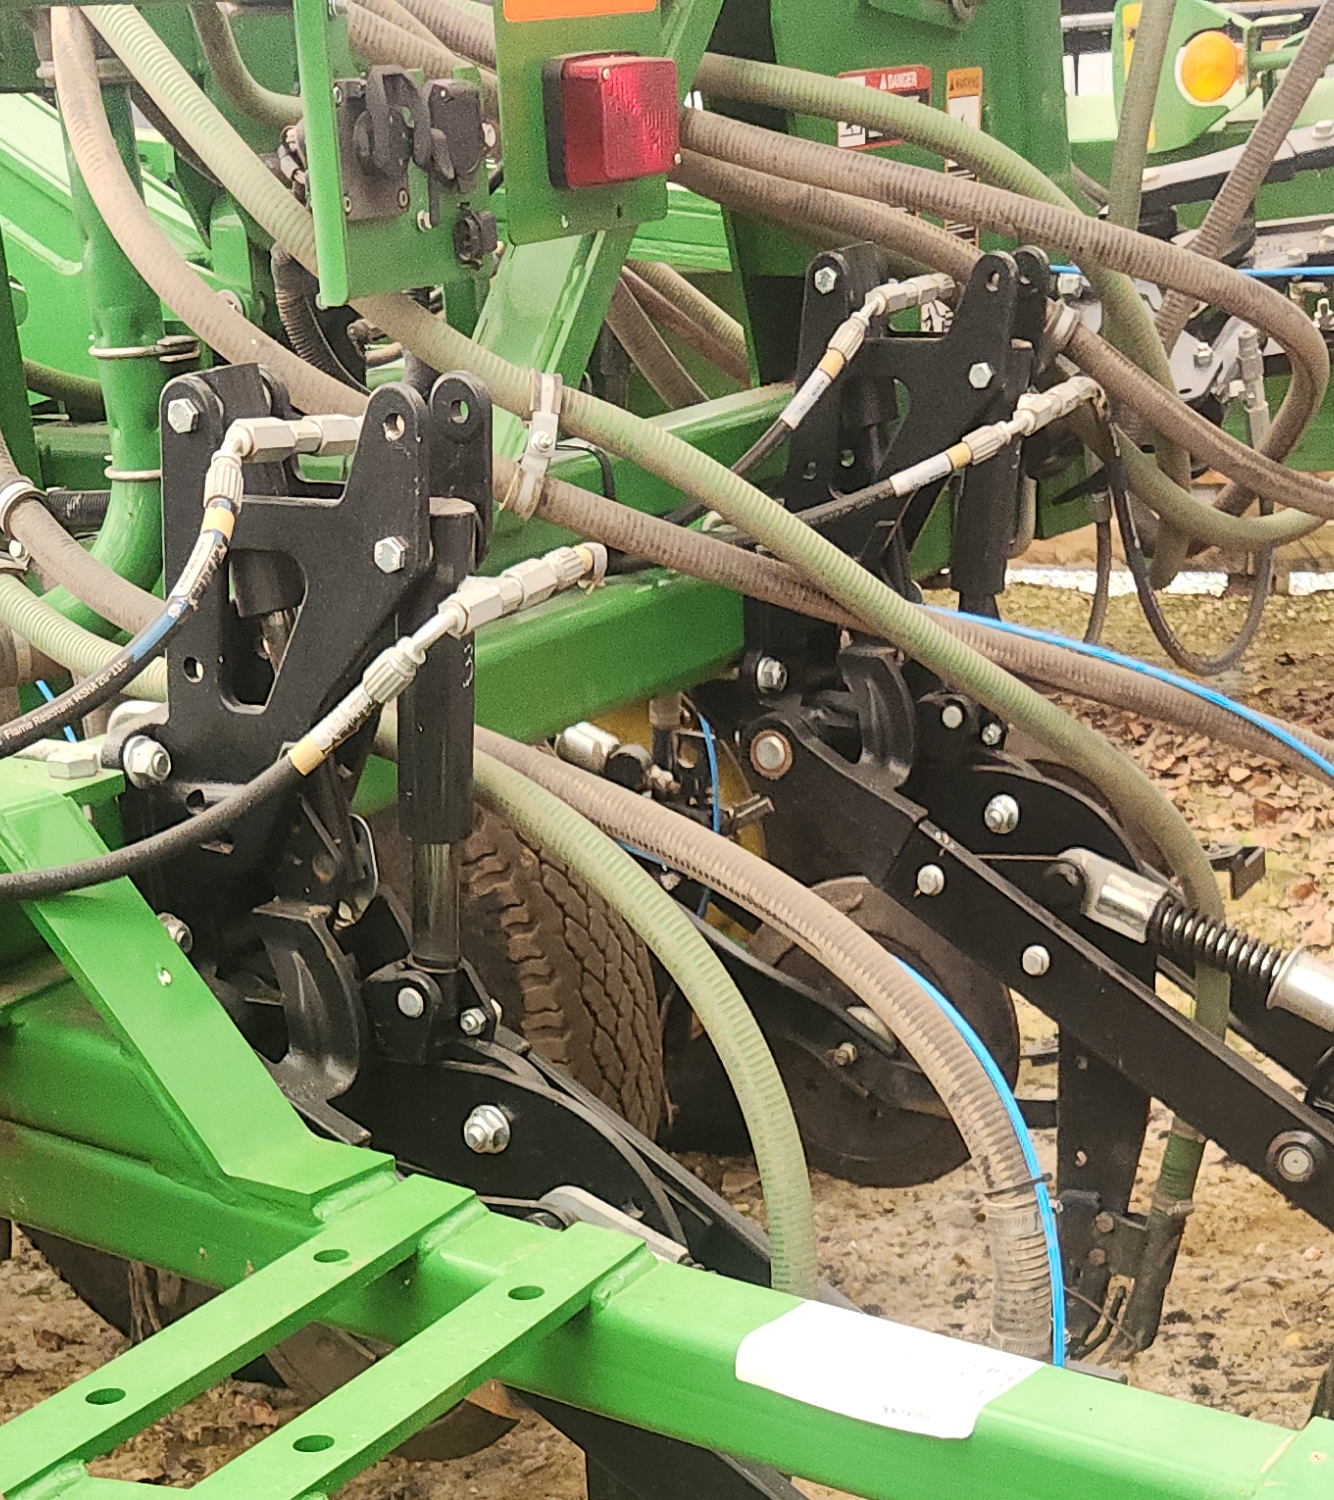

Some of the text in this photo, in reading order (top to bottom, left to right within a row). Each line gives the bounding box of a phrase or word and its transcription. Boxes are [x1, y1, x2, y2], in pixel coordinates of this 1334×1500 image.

[4, 719, 34, 741] Flame
[34, 694, 76, 727] Resistant
[74, 680, 100, 704] MSHA
